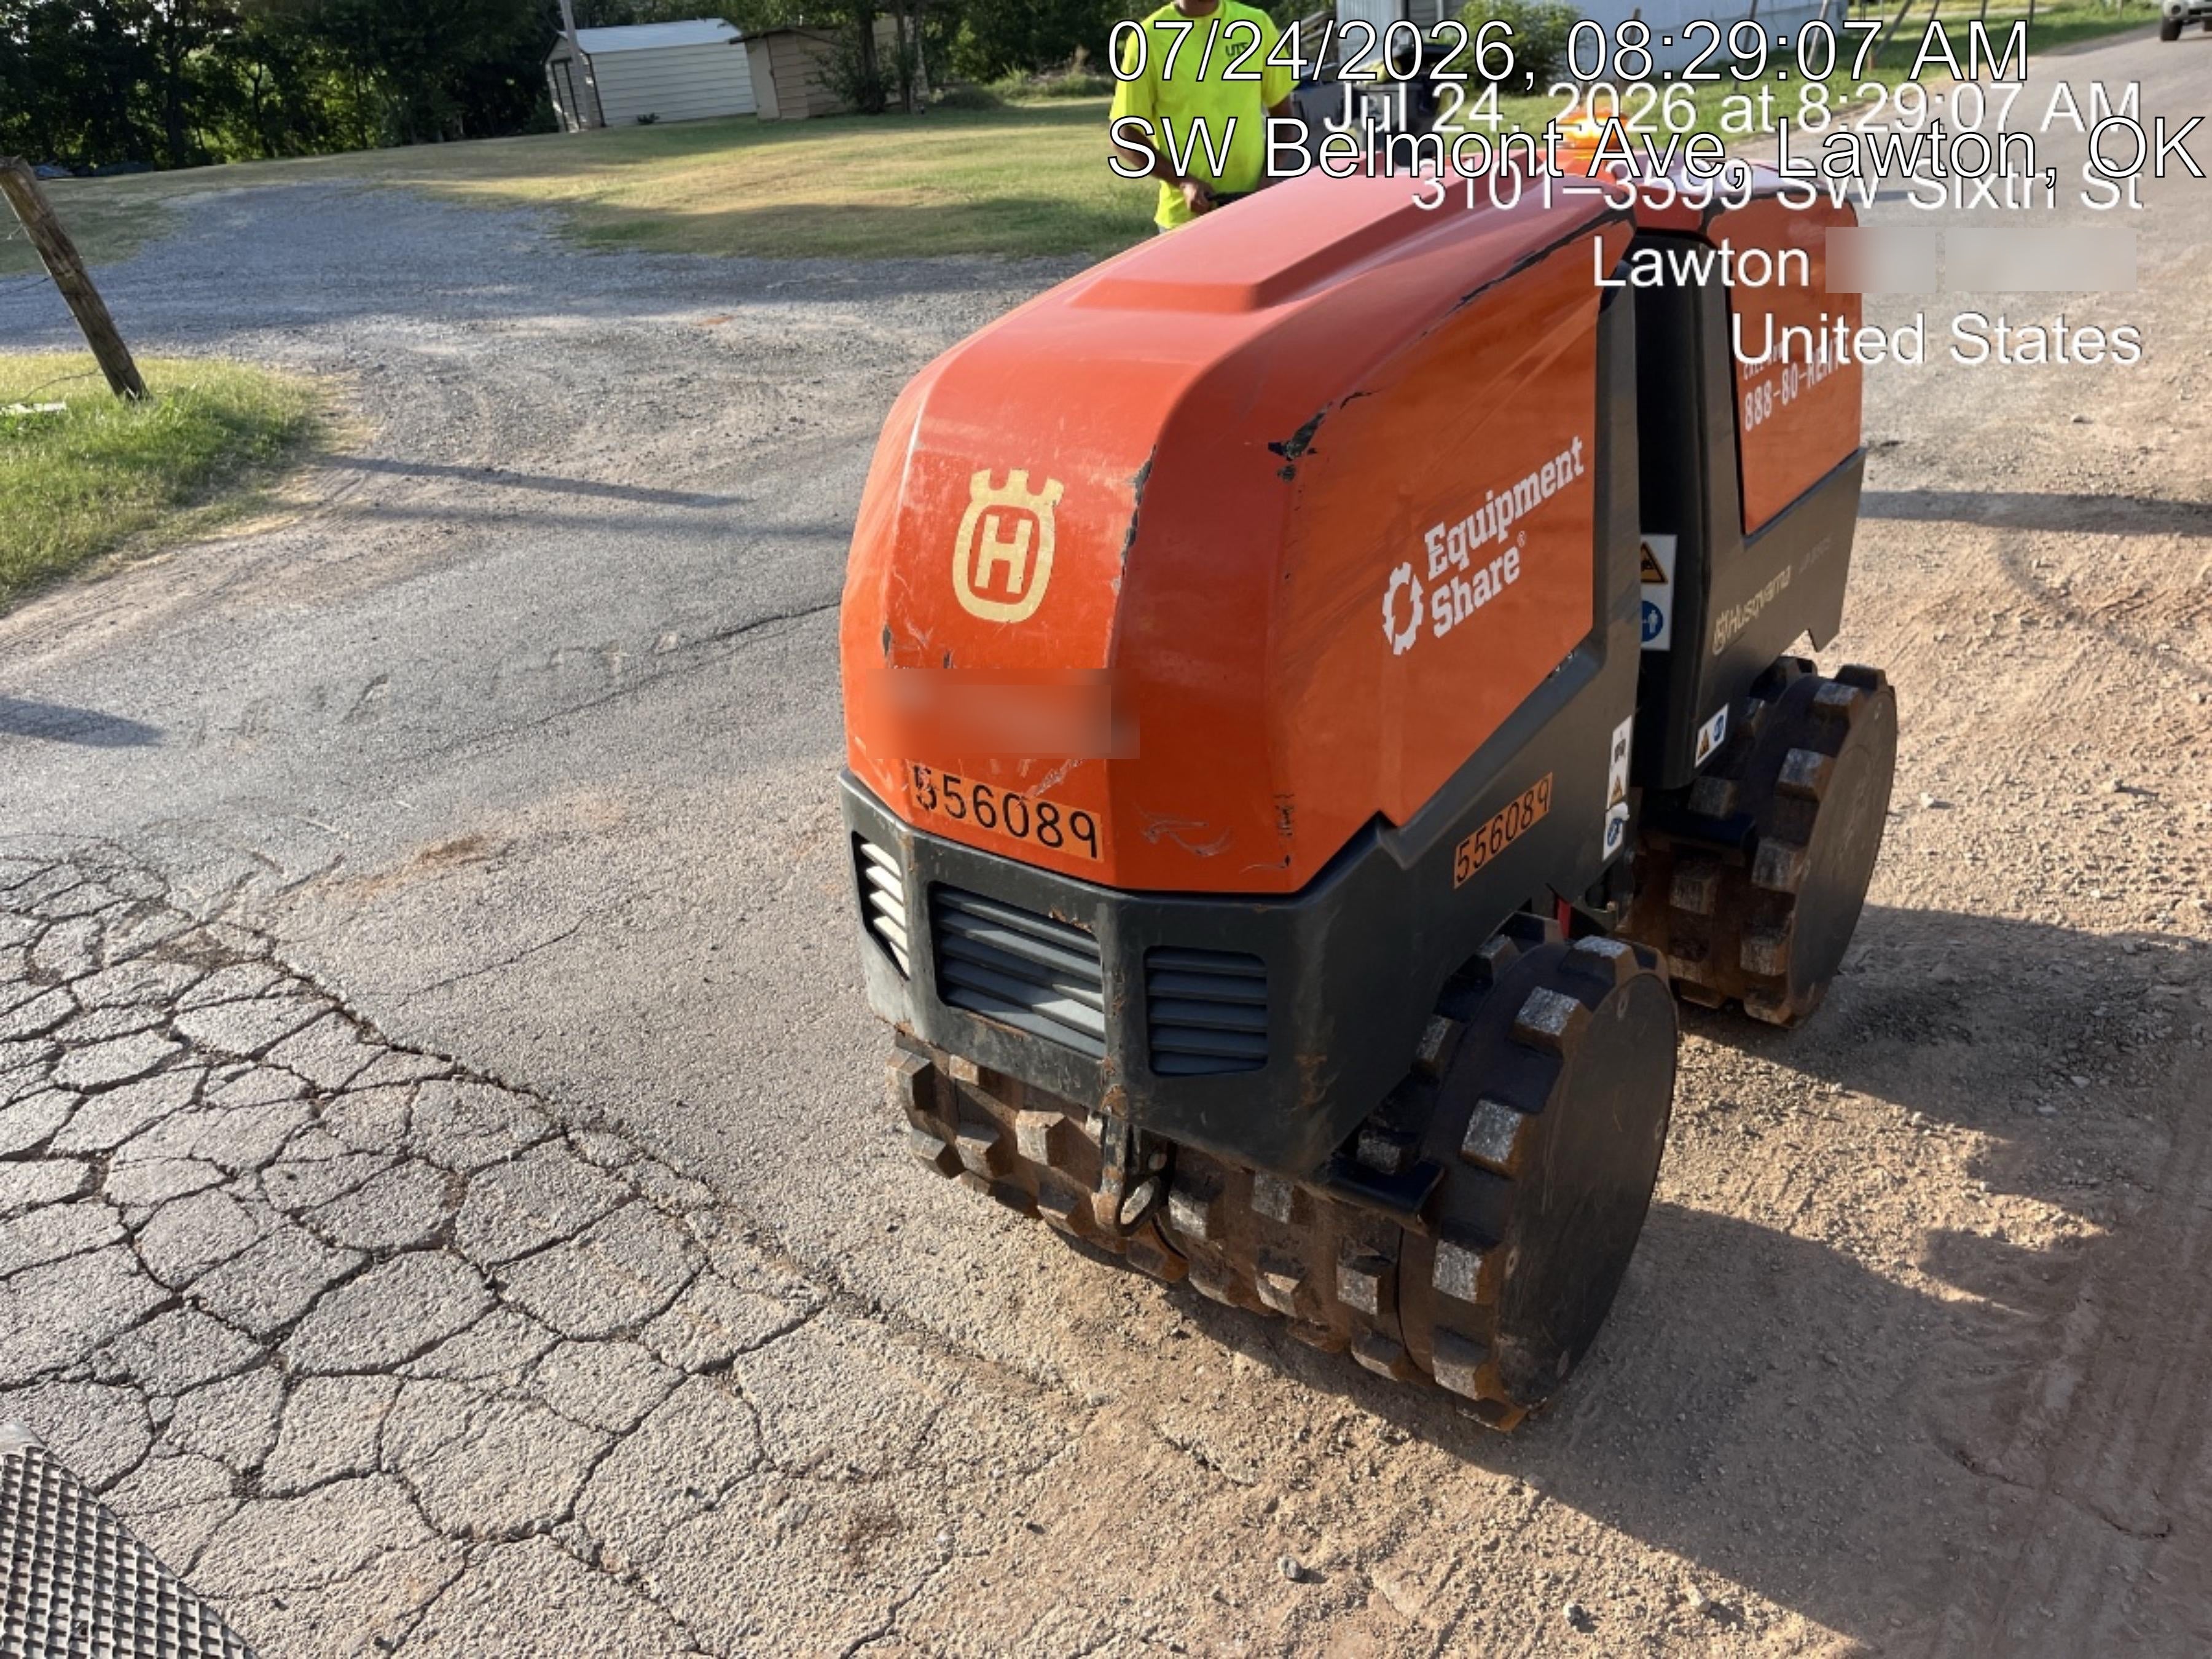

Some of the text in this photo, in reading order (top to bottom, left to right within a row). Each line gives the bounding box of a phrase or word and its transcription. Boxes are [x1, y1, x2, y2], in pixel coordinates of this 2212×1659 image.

[1424, 435, 1584, 581] Equipment
[913, 765, 1098, 858] 556089
[1456, 778, 1549, 882] 556089
